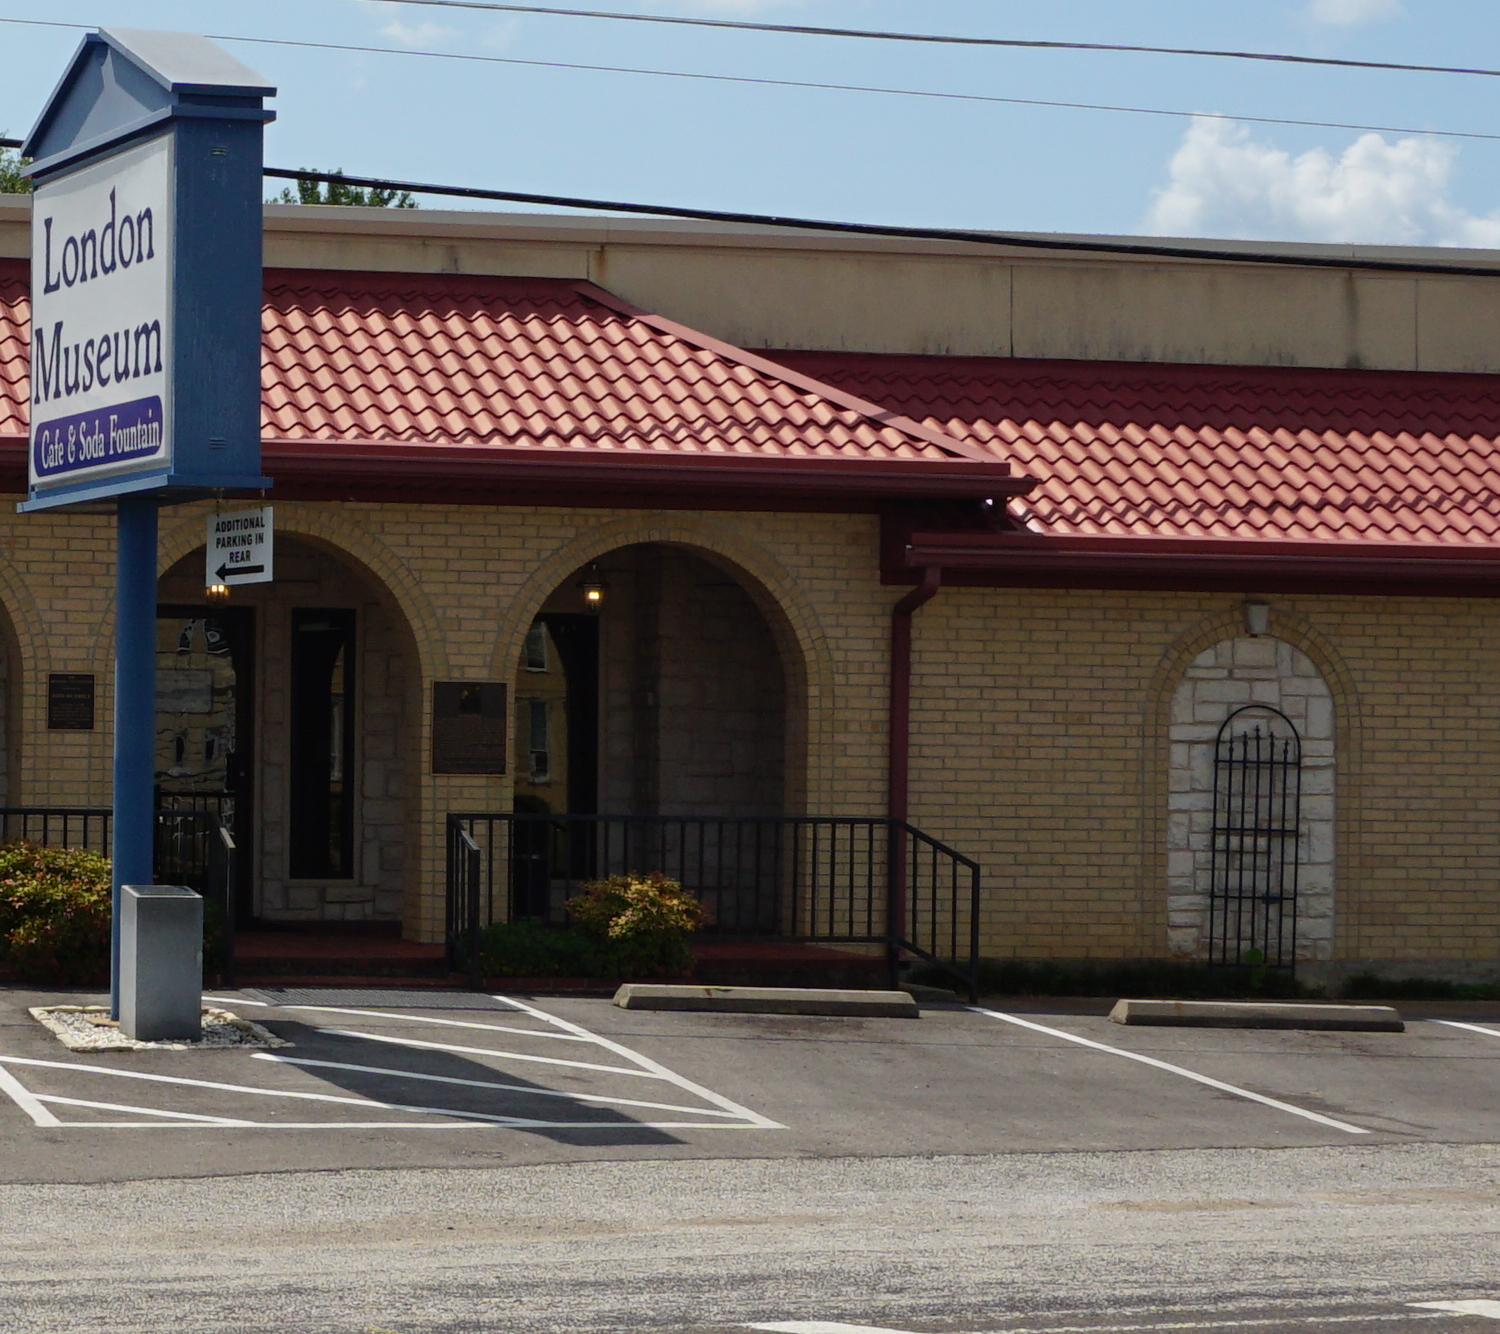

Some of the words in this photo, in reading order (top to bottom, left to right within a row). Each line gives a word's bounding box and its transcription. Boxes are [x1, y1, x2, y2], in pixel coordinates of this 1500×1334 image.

[43, 185, 154, 295] London
[34, 319, 162, 405] Museum
[41, 428, 64, 469] Cafe
[67, 424, 76, 464] &
[79, 419, 105, 461] Soda
[108, 408, 160, 455] Fountain
[215, 515, 265, 534] ADDITIONAL
[216, 533, 253, 549] PARKING
[255, 532, 264, 545] IN
[229, 550, 251, 563] REAR
